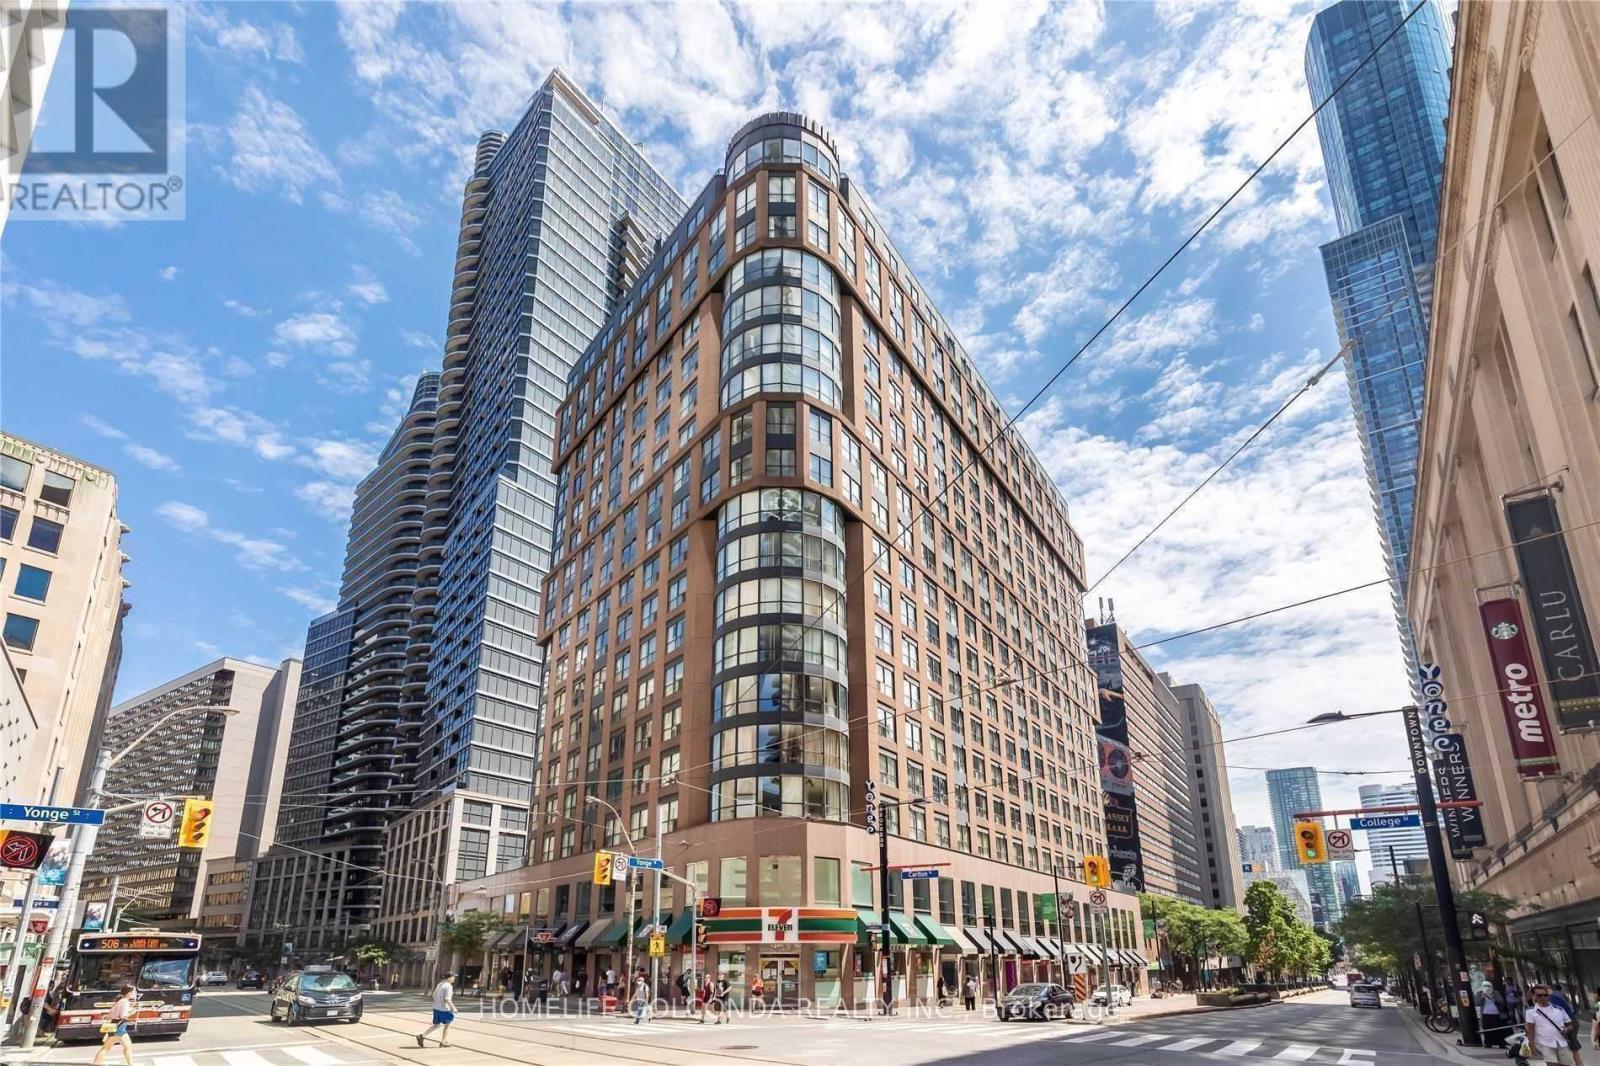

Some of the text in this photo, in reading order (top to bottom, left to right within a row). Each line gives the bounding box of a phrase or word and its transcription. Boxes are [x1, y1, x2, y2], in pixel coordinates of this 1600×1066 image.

[1539, 590, 1585, 682] CARLU
[1504, 663, 1545, 743] metro
[1408, 710, 1427, 774] DOWNTOWN
[1449, 742, 1475, 823] WNNERS
[24, 806, 69, 821] Yonge
[1106, 813, 1130, 822] ASSEY
[1359, 816, 1401, 828] College
[101, 938, 120, 949] 506
